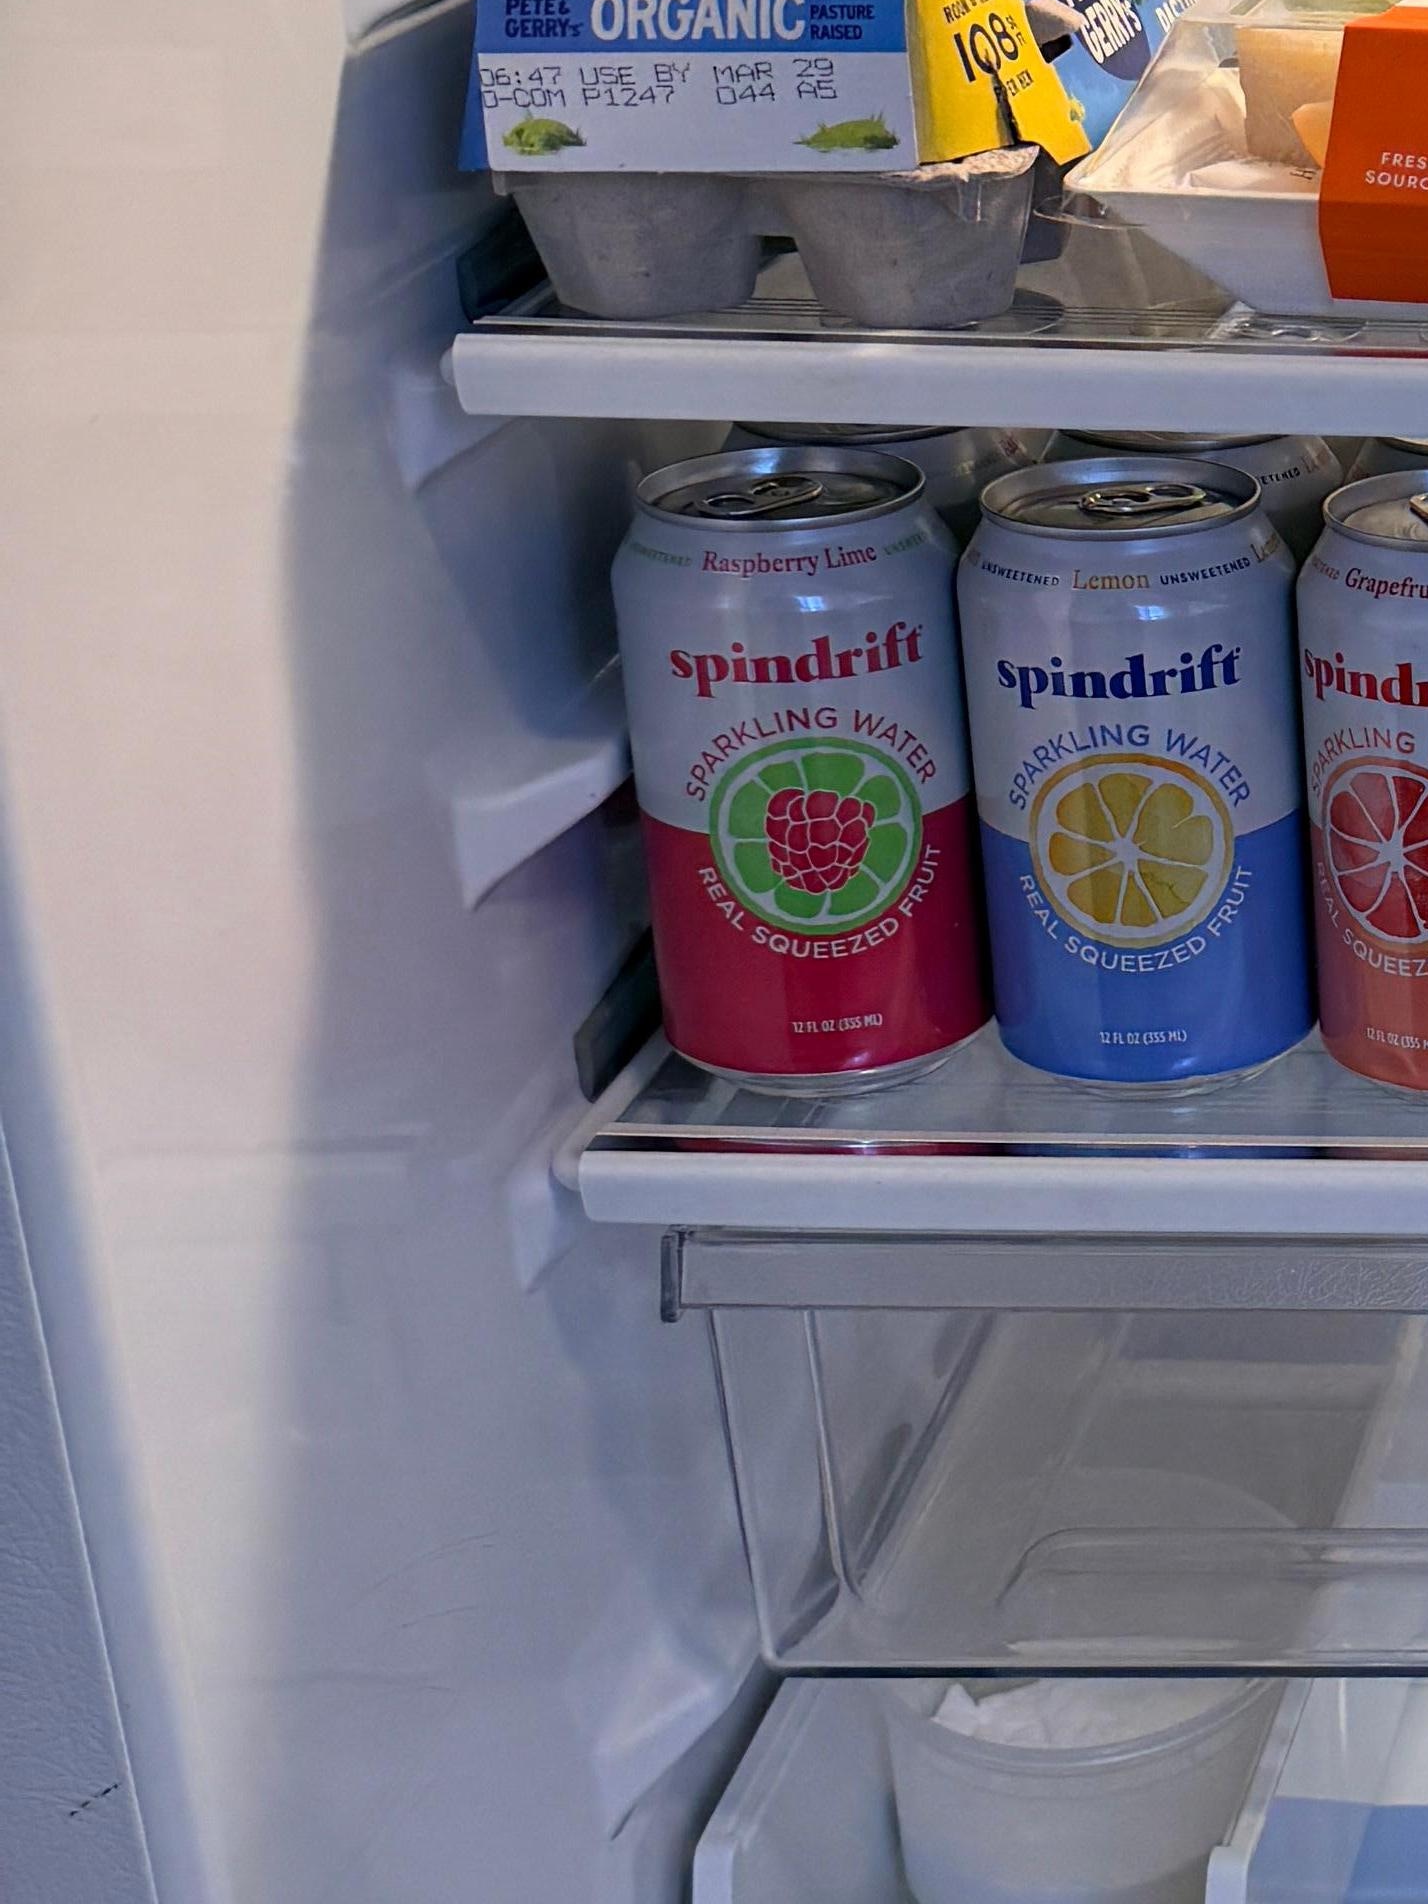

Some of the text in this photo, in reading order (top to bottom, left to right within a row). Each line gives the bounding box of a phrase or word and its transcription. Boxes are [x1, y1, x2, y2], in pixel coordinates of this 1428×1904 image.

[810, 4, 875, 20] PASTURE
[810, 24, 863, 40] RAISED
[579, 66, 636, 86] USE
[712, 61, 773, 84] MAR
[792, 57, 834, 79] 29
[953, 12, 1019, 83] 108
[797, 79, 838, 100] A5
[702, 549, 819, 579] Raspberry
[824, 546, 878, 569] Lime
[1071, 557, 1251, 590] Lemon UNSWEETENED
[669, 621, 923, 699] spindrift
[996, 643, 1242, 710] spindrift
[685, 707, 937, 802] SPARKLING WATER
[1008, 723, 1252, 811] SPARKLING WATER
[1311, 727, 1416, 798] SPARKLING
[697, 844, 941, 959] REAL SQUEEZED FRUIT
[1019, 865, 1253, 974] REAL SQUEEZED FRUIT
[1099, 1029, 1187, 1045] 12 FL OZ (355 ML)
